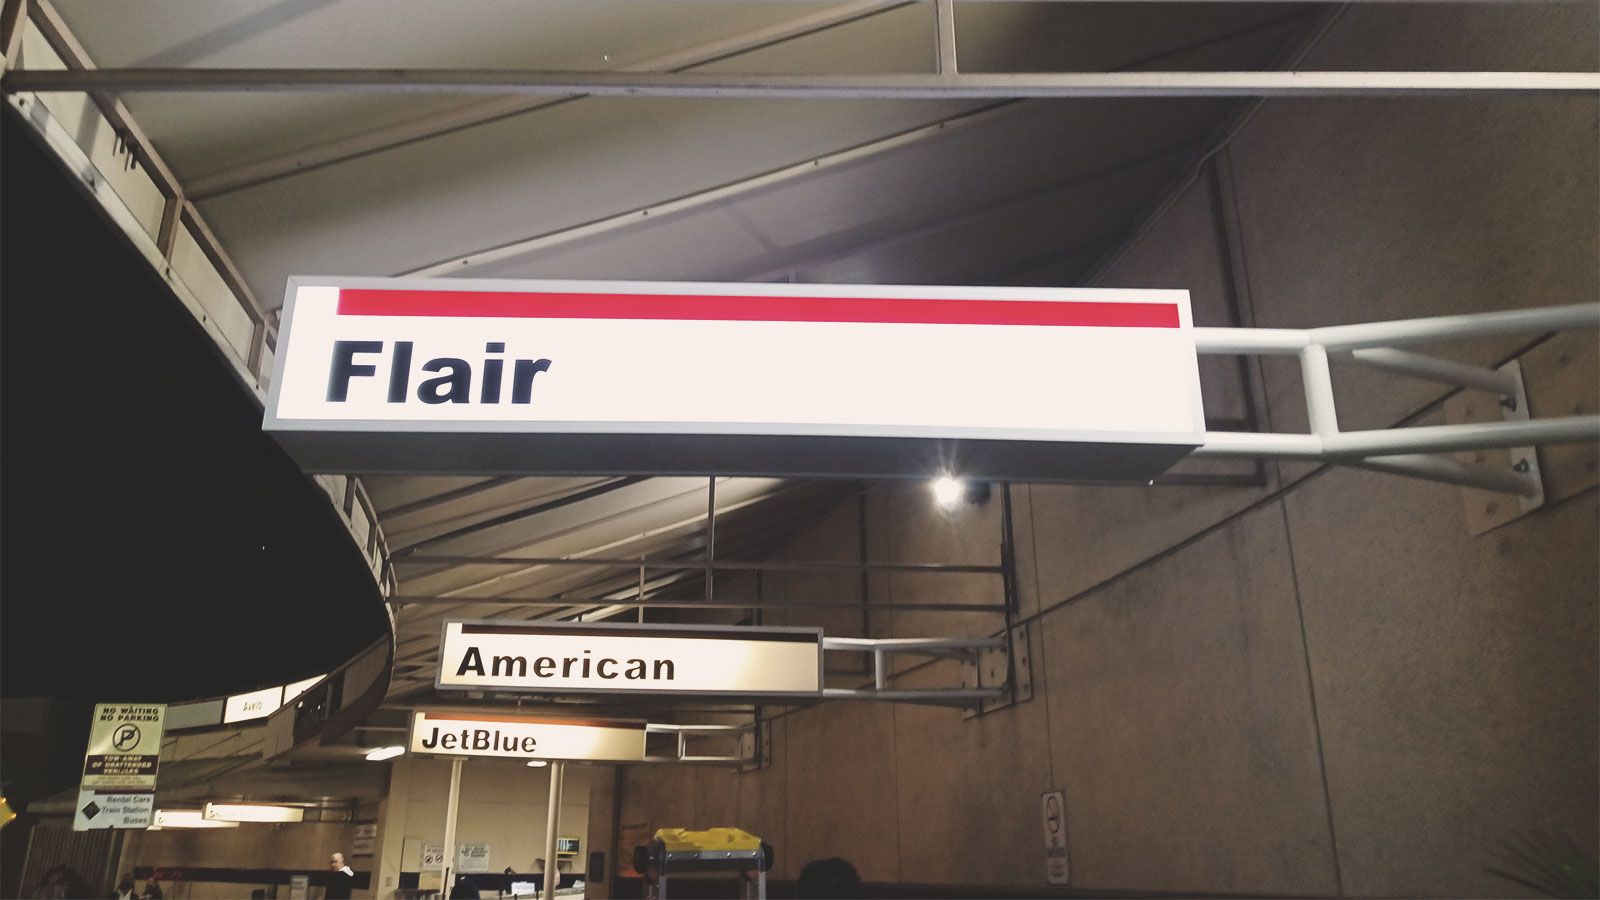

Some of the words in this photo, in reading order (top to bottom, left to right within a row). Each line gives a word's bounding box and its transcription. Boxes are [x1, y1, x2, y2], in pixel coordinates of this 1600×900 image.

[326, 340, 552, 405] Flair
[456, 646, 676, 681] American
[121, 707, 159, 715] WAITING
[422, 727, 537, 753] JetBlue
[92, 761, 103, 769] OF
[107, 796, 132, 804] Rental
[133, 796, 151, 804] Cars
[122, 806, 149, 815] Station
[123, 817, 148, 825] Buses
